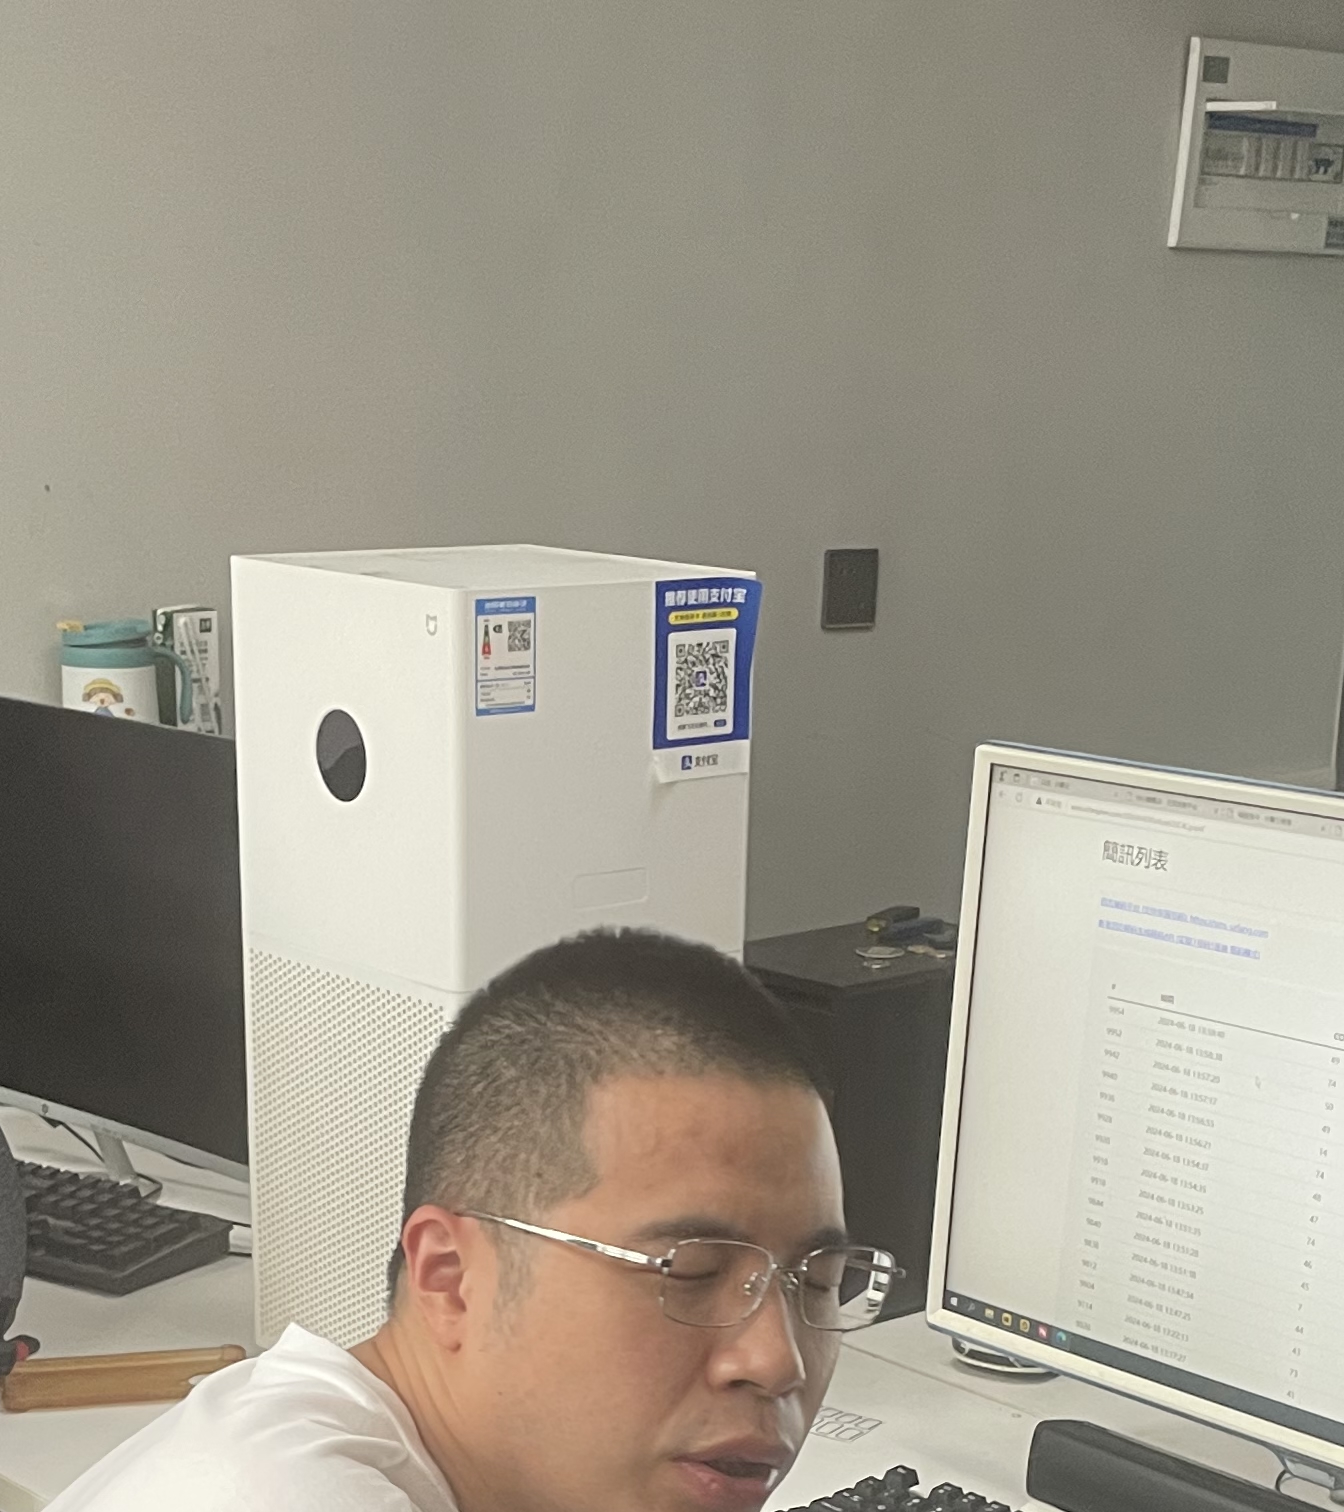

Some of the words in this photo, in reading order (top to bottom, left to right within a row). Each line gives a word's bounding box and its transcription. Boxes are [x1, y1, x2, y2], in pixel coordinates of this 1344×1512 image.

[694, 754, 718, 767] 支付宝
[1102, 839, 1169, 871] 簡訊列表
[1327, 1078, 1337, 1088] 74
[1324, 1102, 1334, 1111] 50
[1315, 1170, 1325, 1180] 74
[1306, 1236, 1316, 1247] 74
